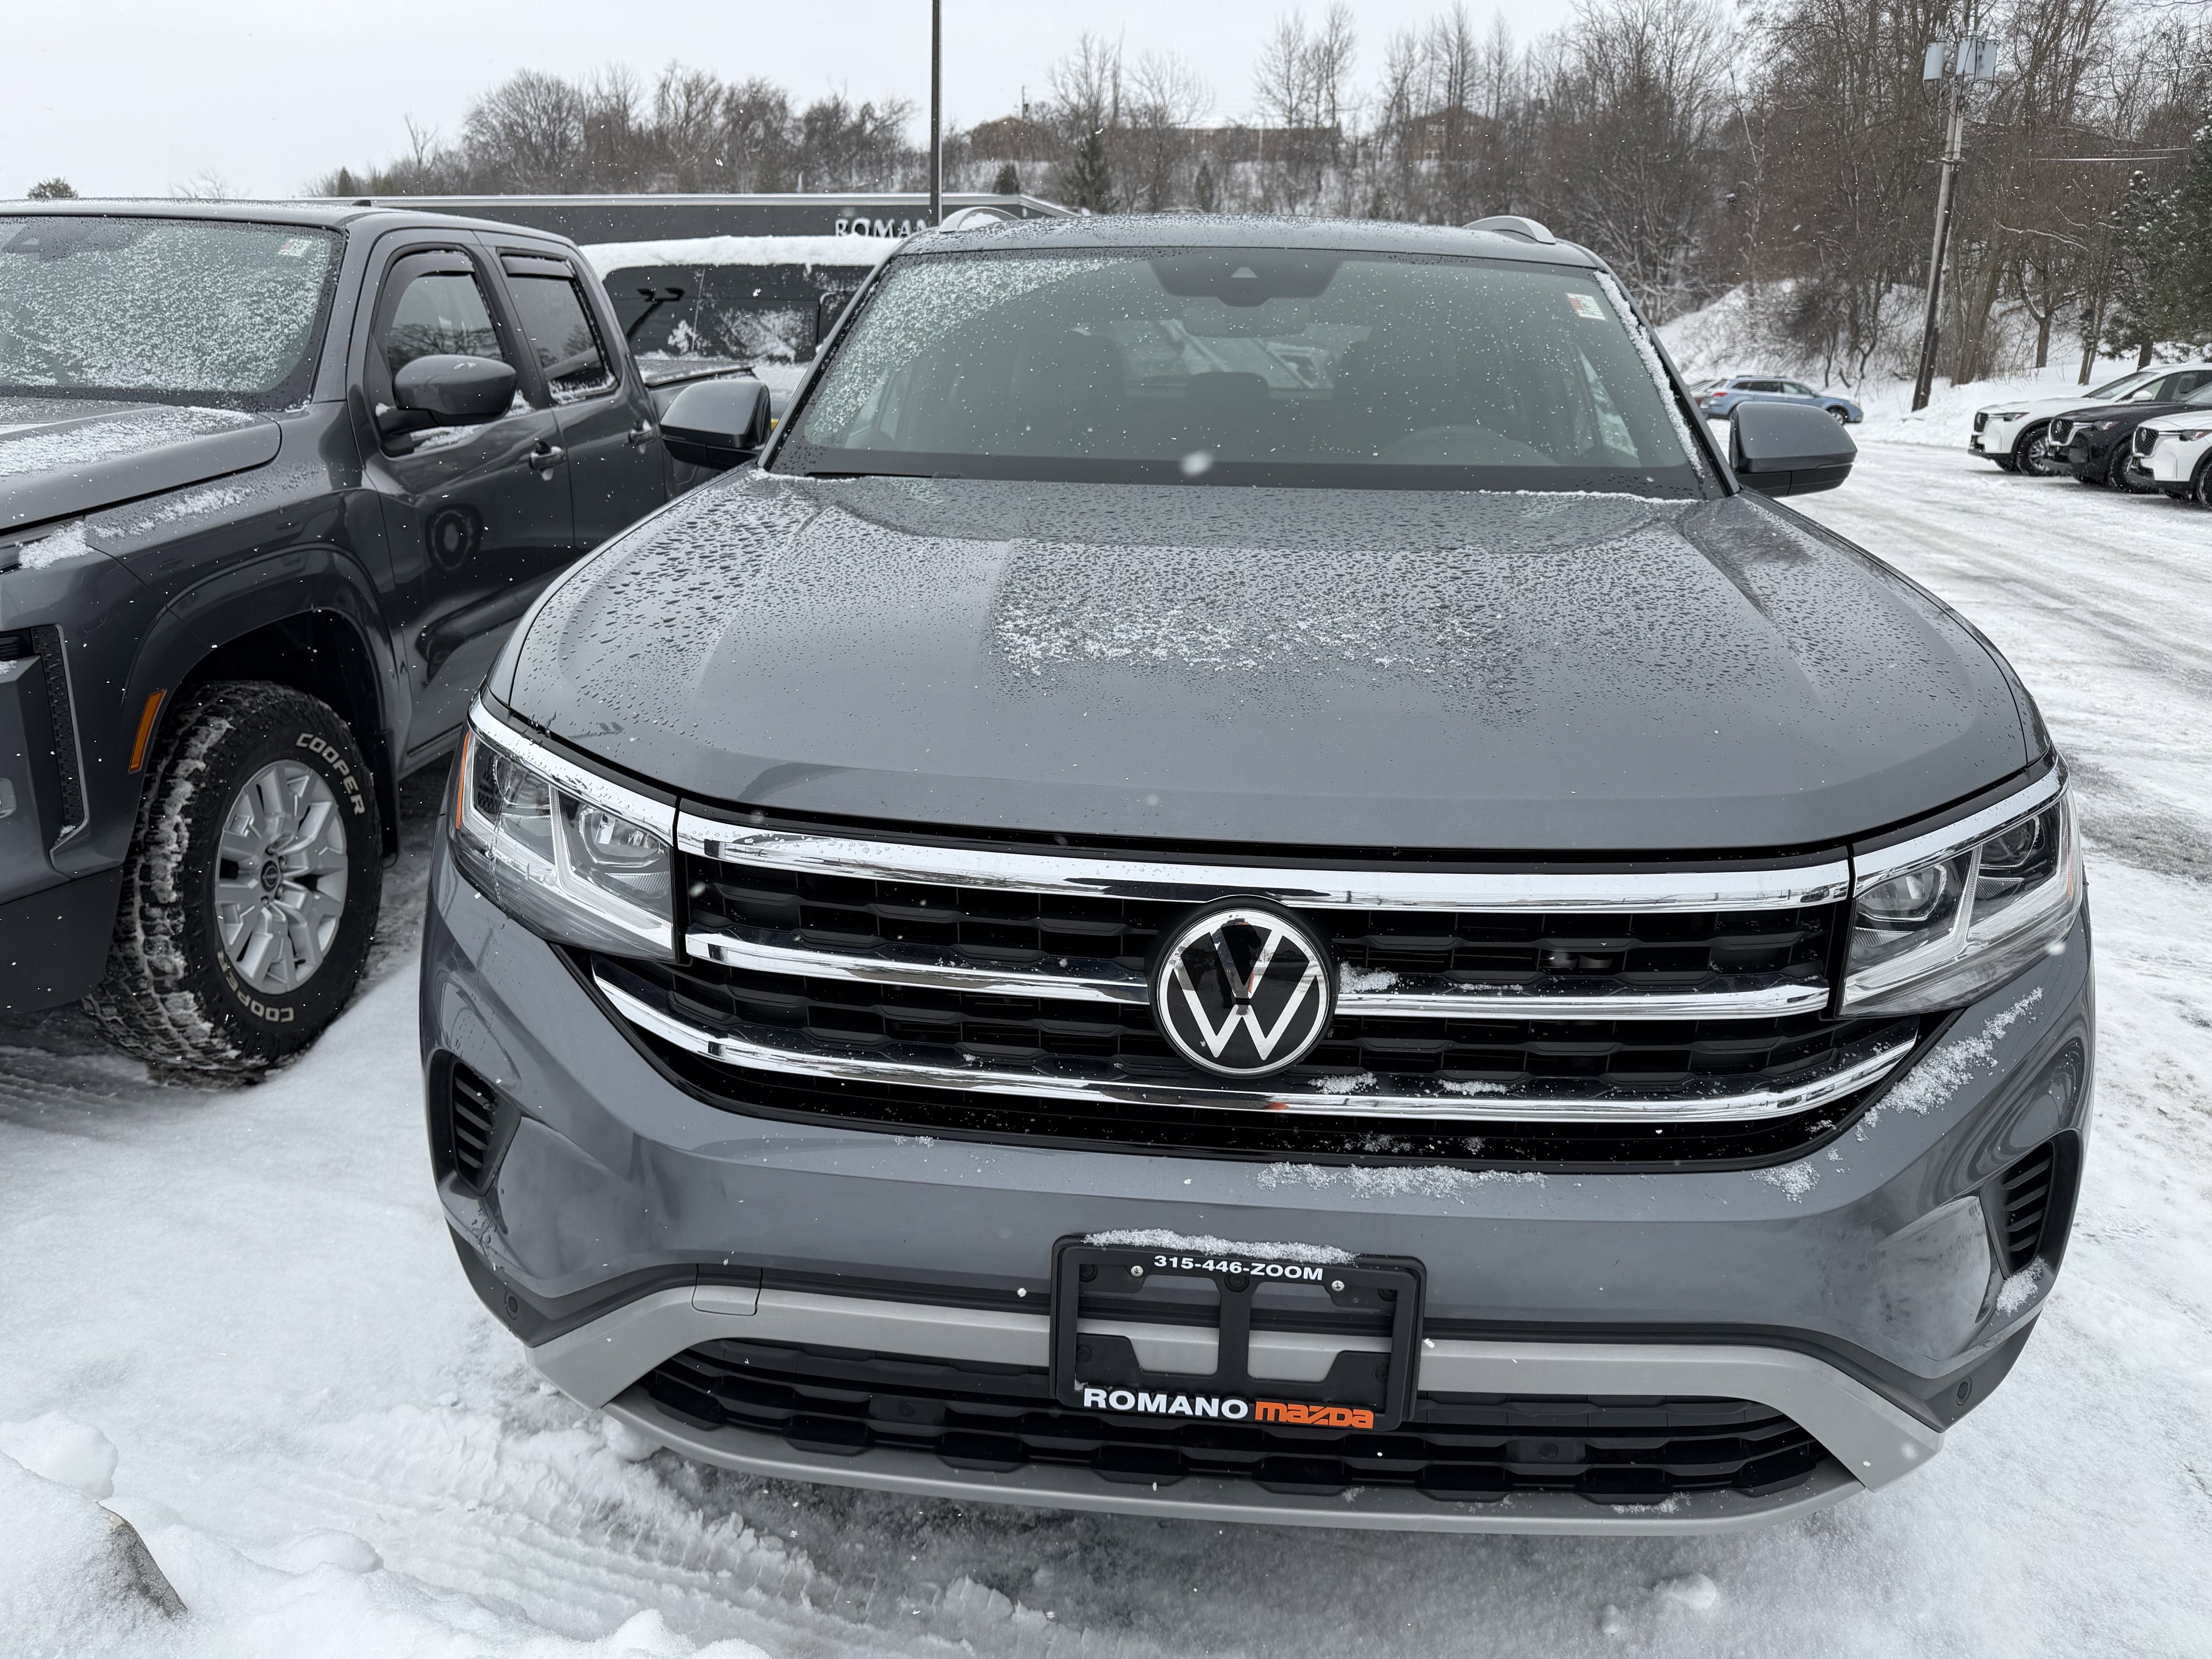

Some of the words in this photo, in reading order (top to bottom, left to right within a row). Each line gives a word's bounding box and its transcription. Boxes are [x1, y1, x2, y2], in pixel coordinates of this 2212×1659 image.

[296, 733, 365, 815] COOPER
[217, 950, 294, 1022] COOPER
[1154, 1255, 1323, 1281] 315-446-ZOOM
[1084, 1388, 1248, 1419] ROMANO
